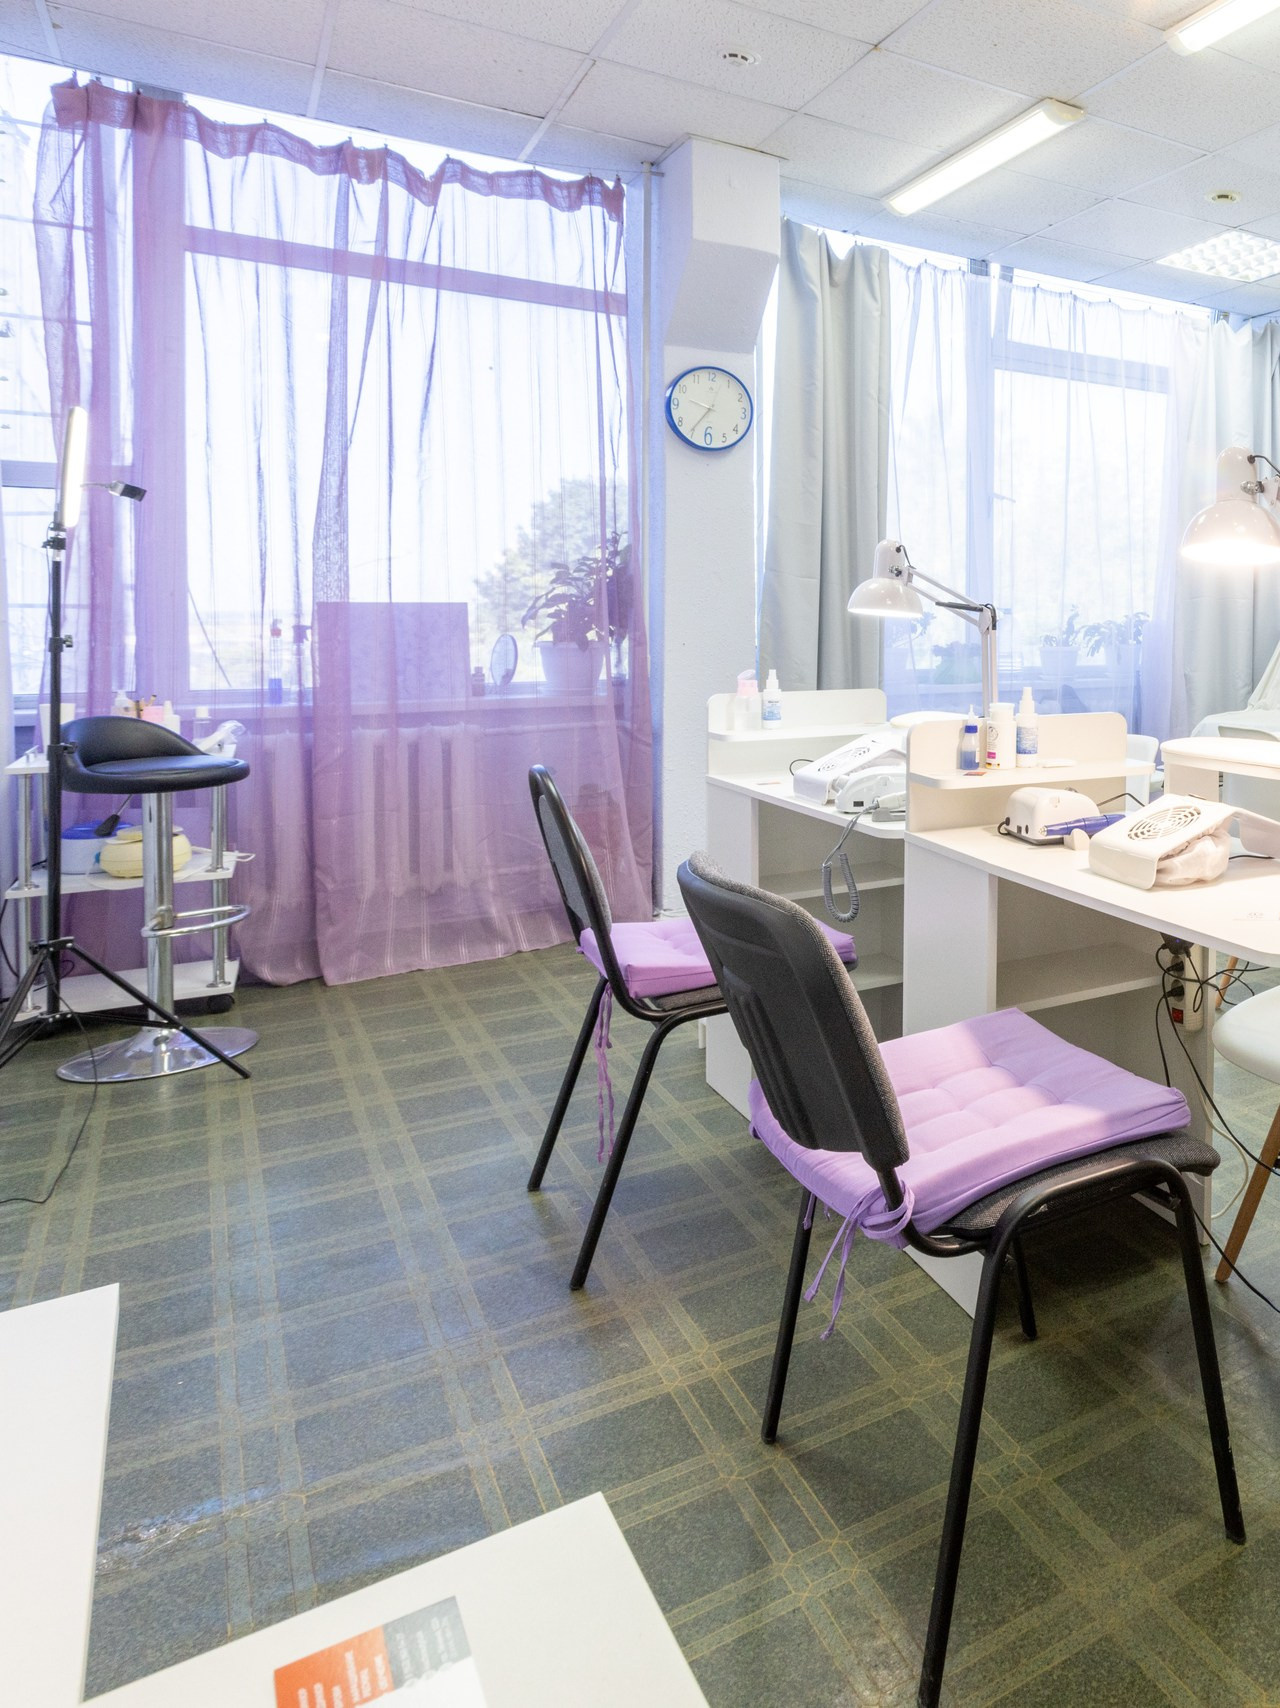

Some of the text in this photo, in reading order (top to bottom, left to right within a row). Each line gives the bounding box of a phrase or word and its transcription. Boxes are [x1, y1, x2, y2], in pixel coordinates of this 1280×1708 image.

[693, 374, 700, 384] 11
[708, 372, 716, 382] 12
[678, 384, 687, 394] 10
[738, 393, 743, 402] 2
[672, 398, 679, 410] 9
[741, 407, 747, 419] 3
[678, 417, 683, 427] 8
[733, 424, 738, 434] 4
[704, 426, 712, 445] 6
[722, 433, 727, 443] 5
